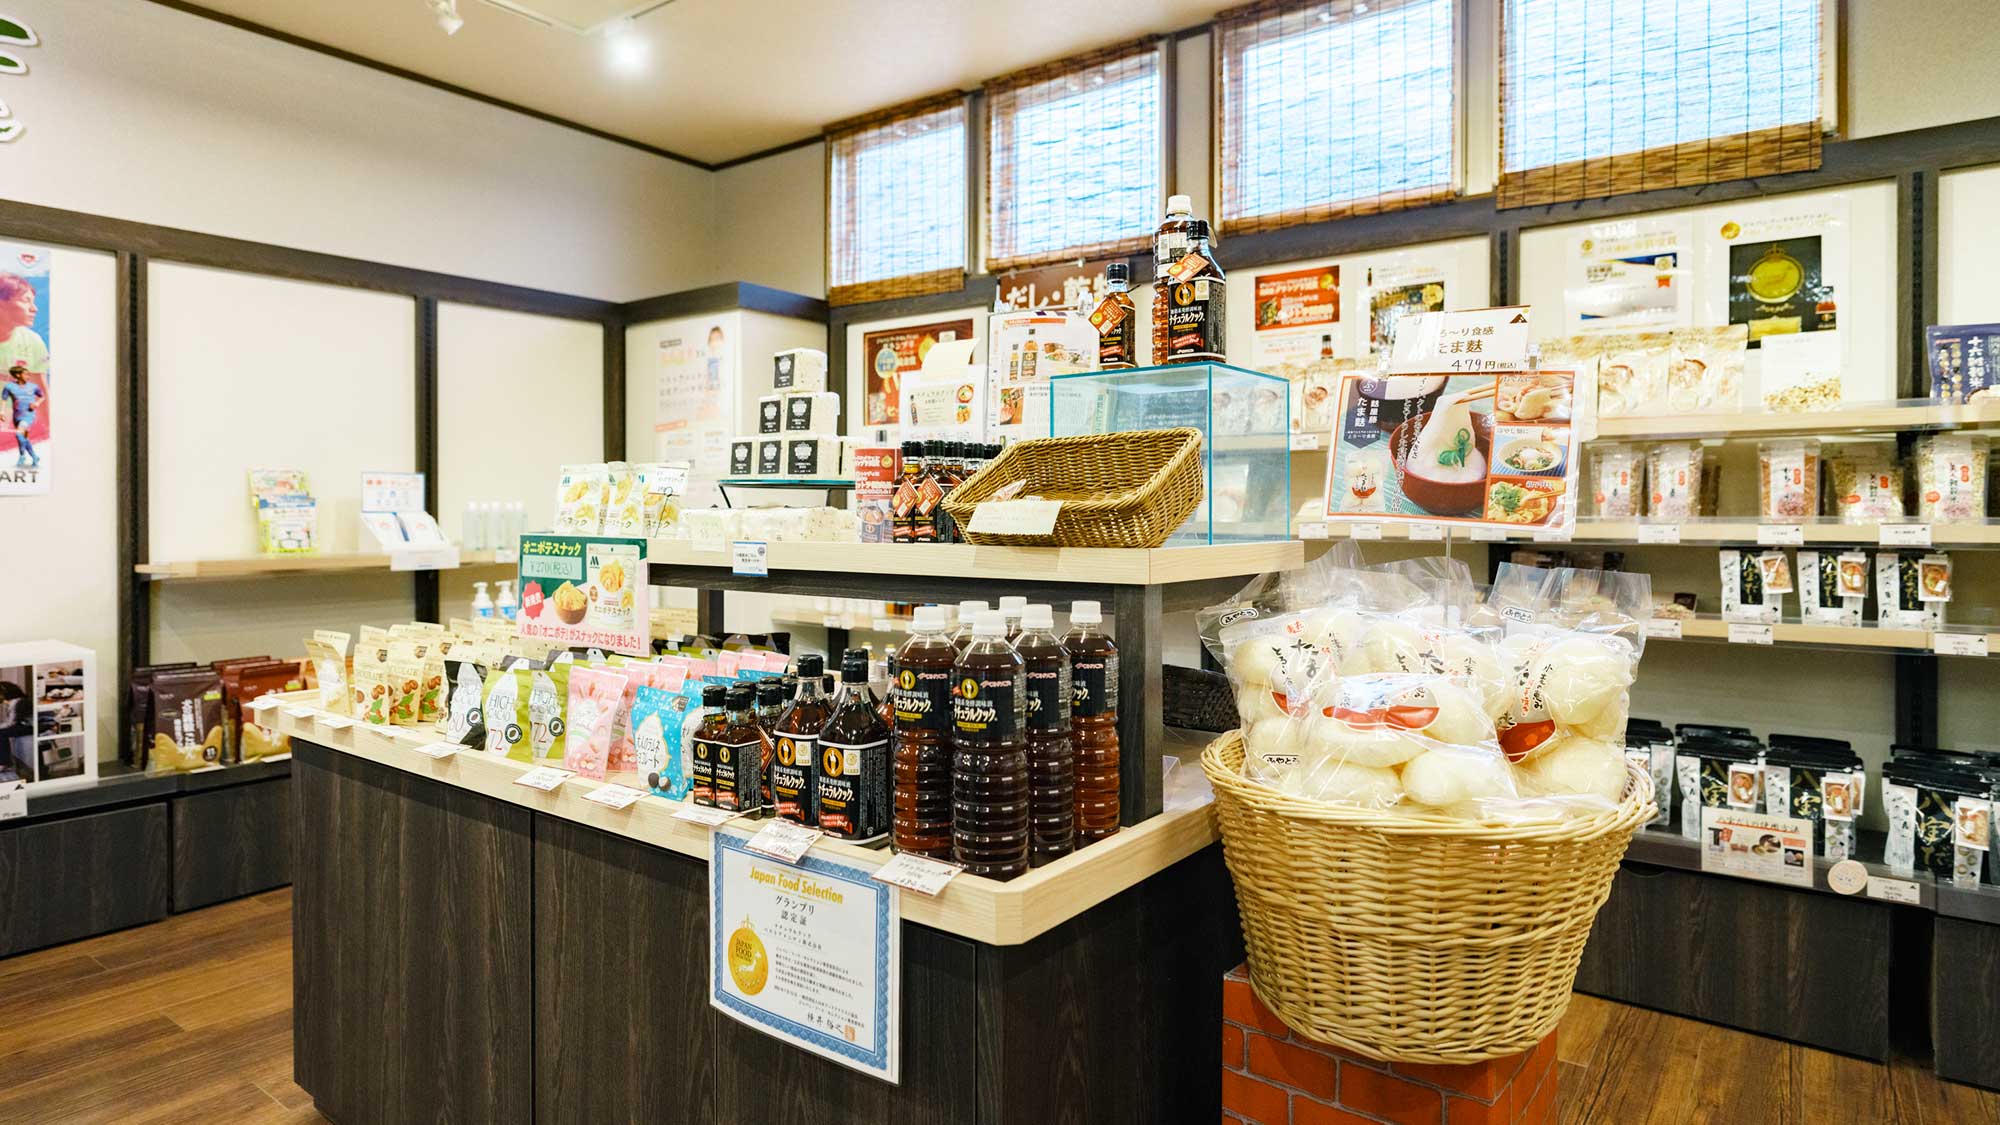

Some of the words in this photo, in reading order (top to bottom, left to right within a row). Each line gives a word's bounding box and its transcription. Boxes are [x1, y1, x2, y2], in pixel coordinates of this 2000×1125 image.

[750, 866, 776, 884] Japan
[778, 873, 800, 891] Food
[801, 879, 843, 904] Selection
[776, 895, 814, 915] グランプリ
